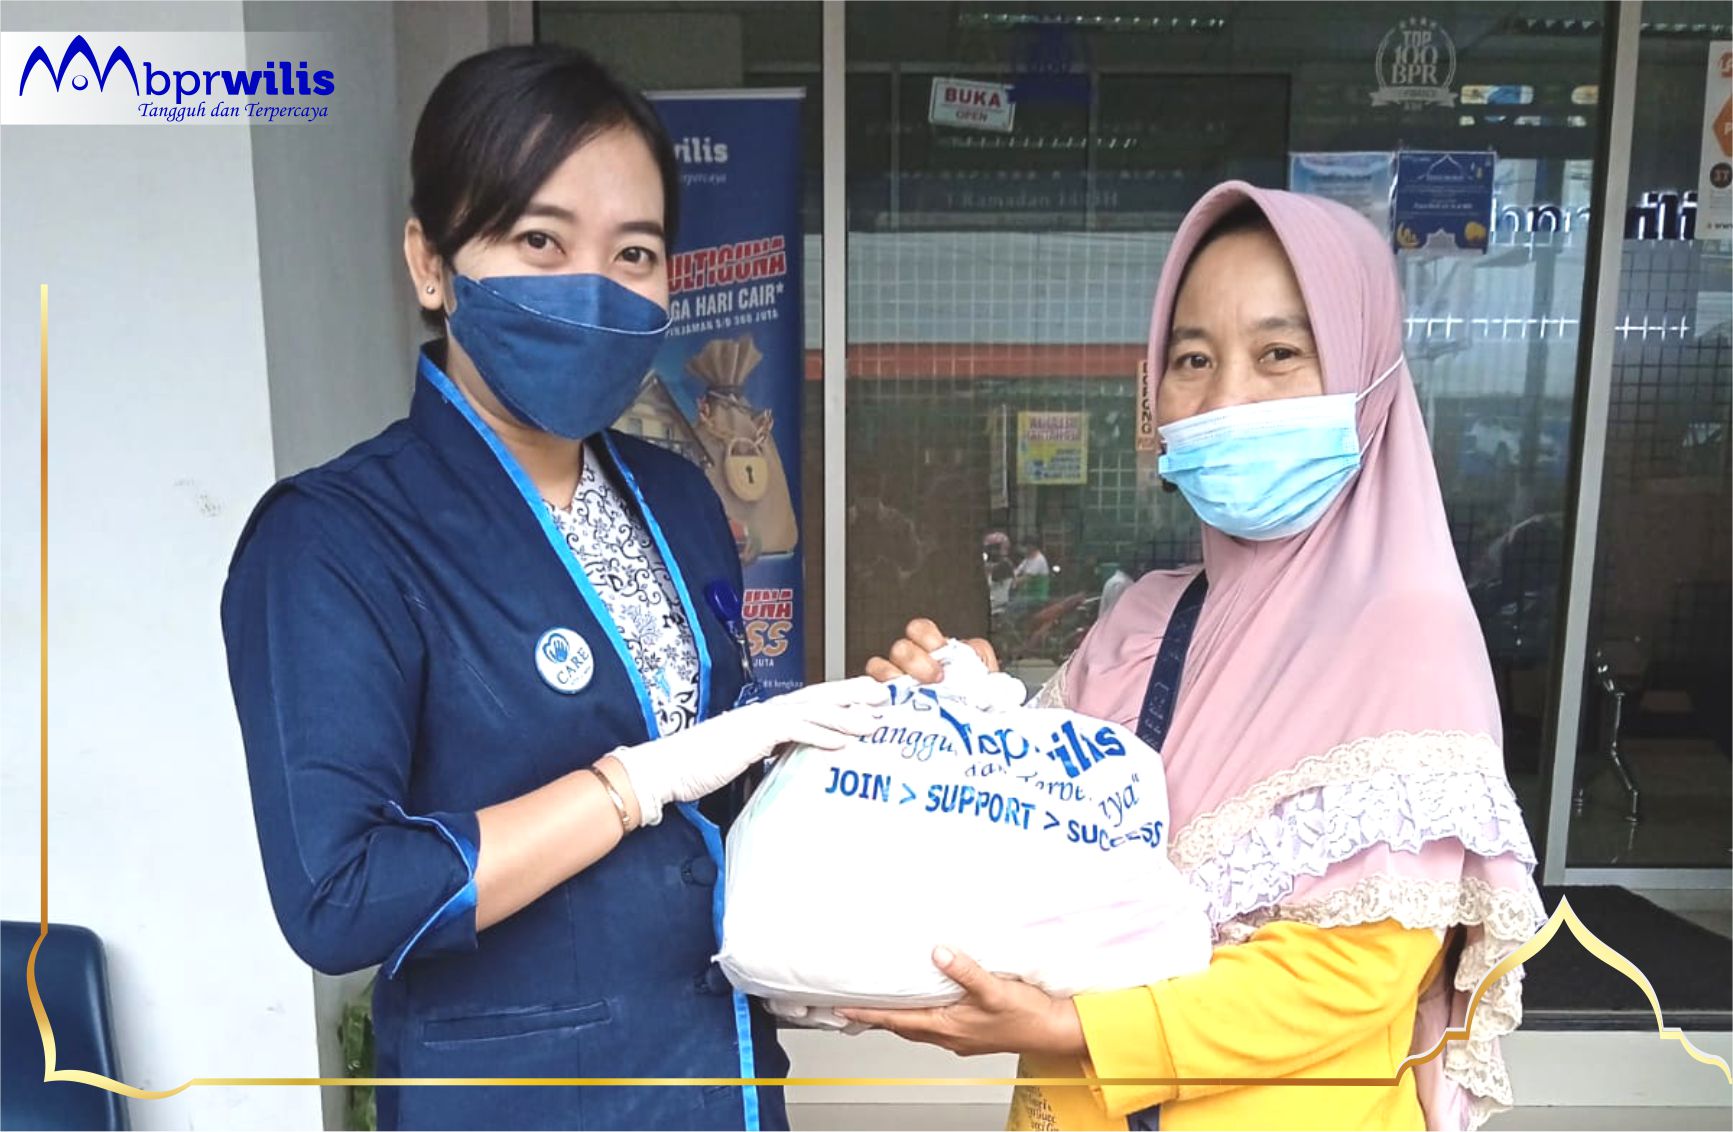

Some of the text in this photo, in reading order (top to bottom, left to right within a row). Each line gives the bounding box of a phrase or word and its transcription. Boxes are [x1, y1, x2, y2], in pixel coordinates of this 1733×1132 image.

[1402, 30, 1433, 47] TOP
[1391, 64, 1438, 85] BPR
[945, 86, 1001, 108] BUKA
[955, 111, 989, 122] OPEN
[667, 235, 787, 294] ULTIGUNA
[670, 298, 691, 321] GA
[695, 291, 734, 317] HARI
[742, 588, 793, 620] UNA
[745, 620, 793, 657] SS
[556, 646, 590, 685] CARE
[753, 659, 775, 668] JUTA
[825, 767, 892, 803] JOIN
[925, 784, 1036, 830] SUPPORT
